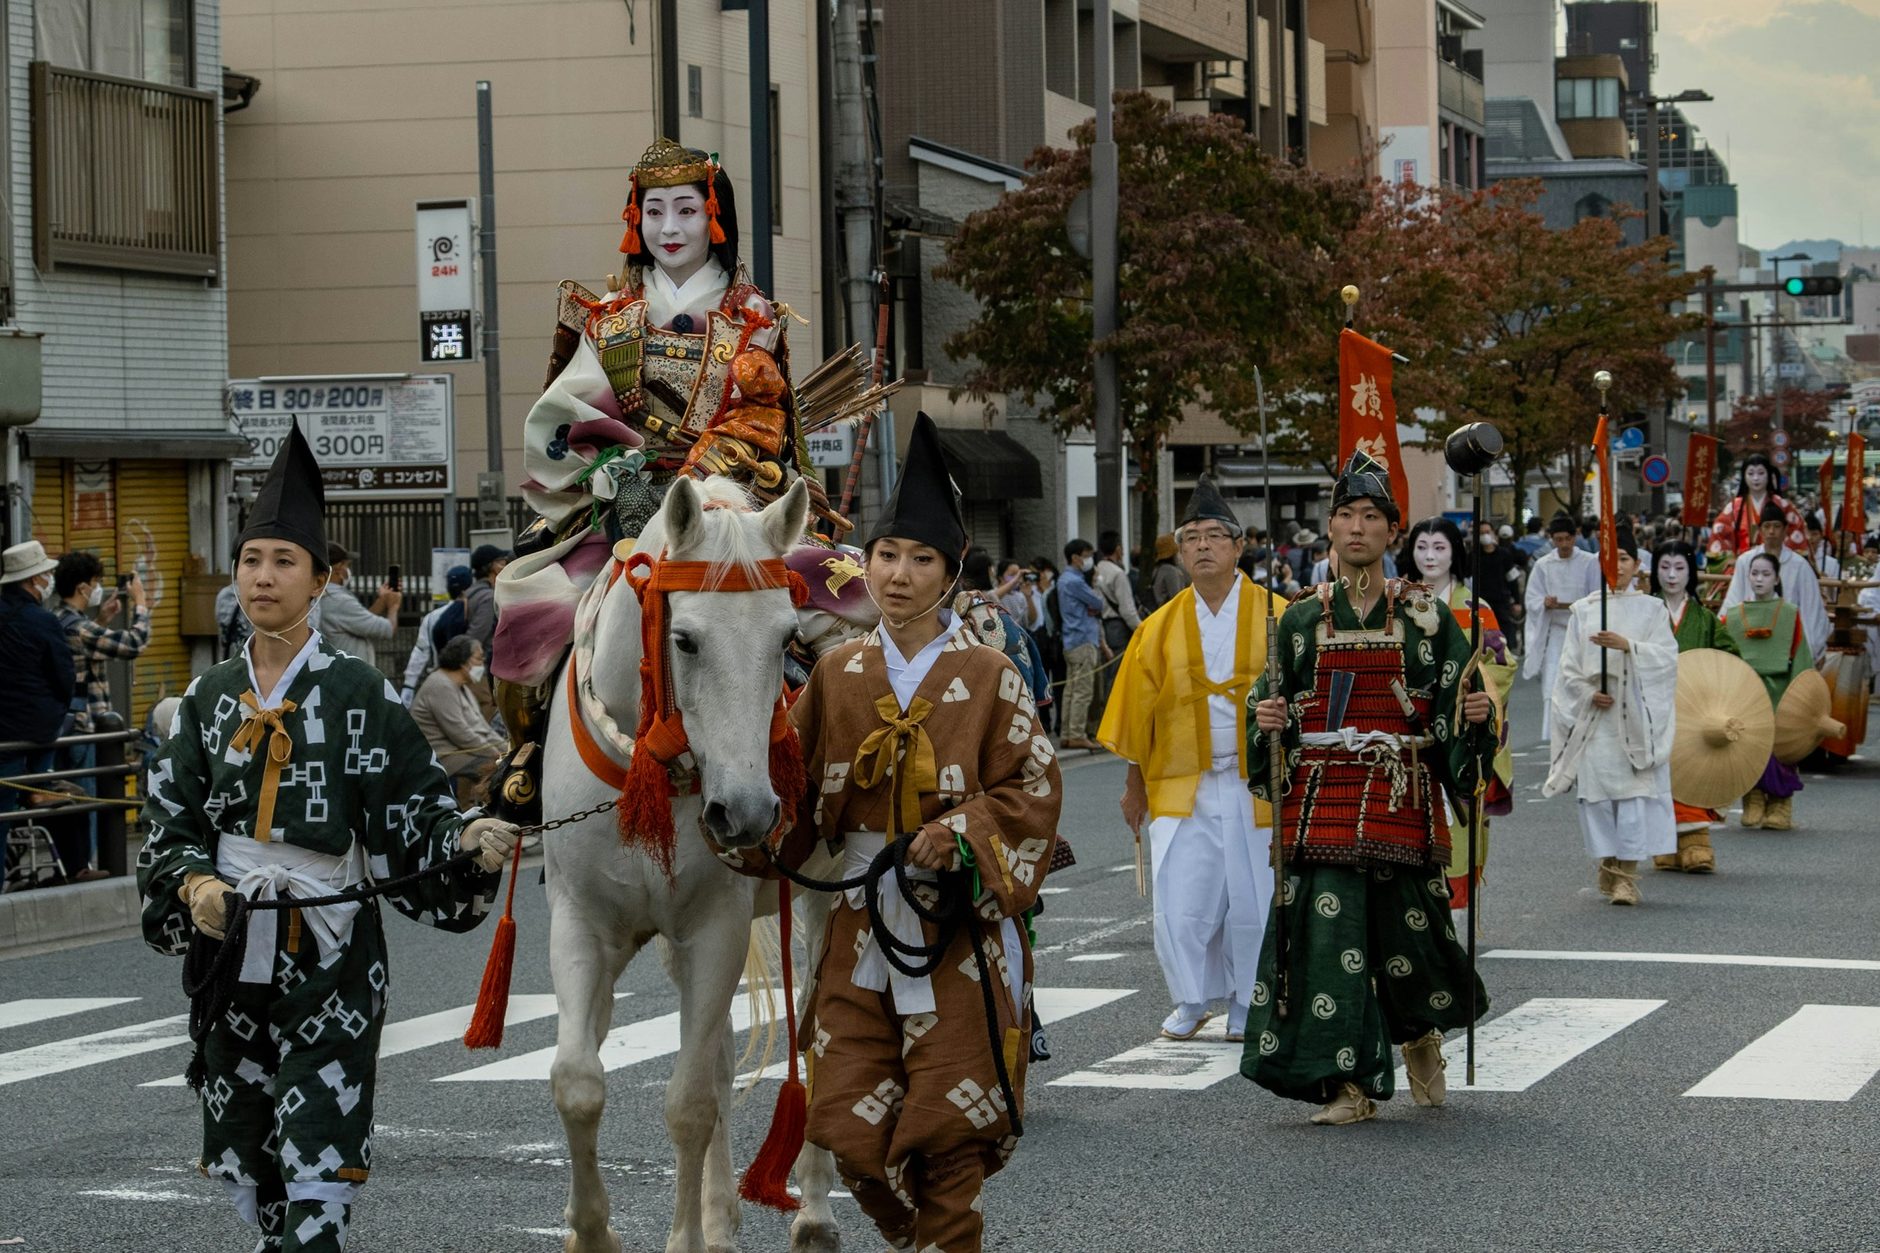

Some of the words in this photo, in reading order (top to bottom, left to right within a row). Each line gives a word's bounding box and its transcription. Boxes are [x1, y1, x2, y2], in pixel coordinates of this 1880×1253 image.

[432, 265, 458, 277] 24H
[431, 323, 464, 359] 満
[234, 389, 275, 410] 終日
[283, 386, 383, 409] 30分200円
[320, 415, 375, 426] 夜間最大料金
[316, 435, 384, 456] 300円
[395, 470, 445, 484] コンセプト
